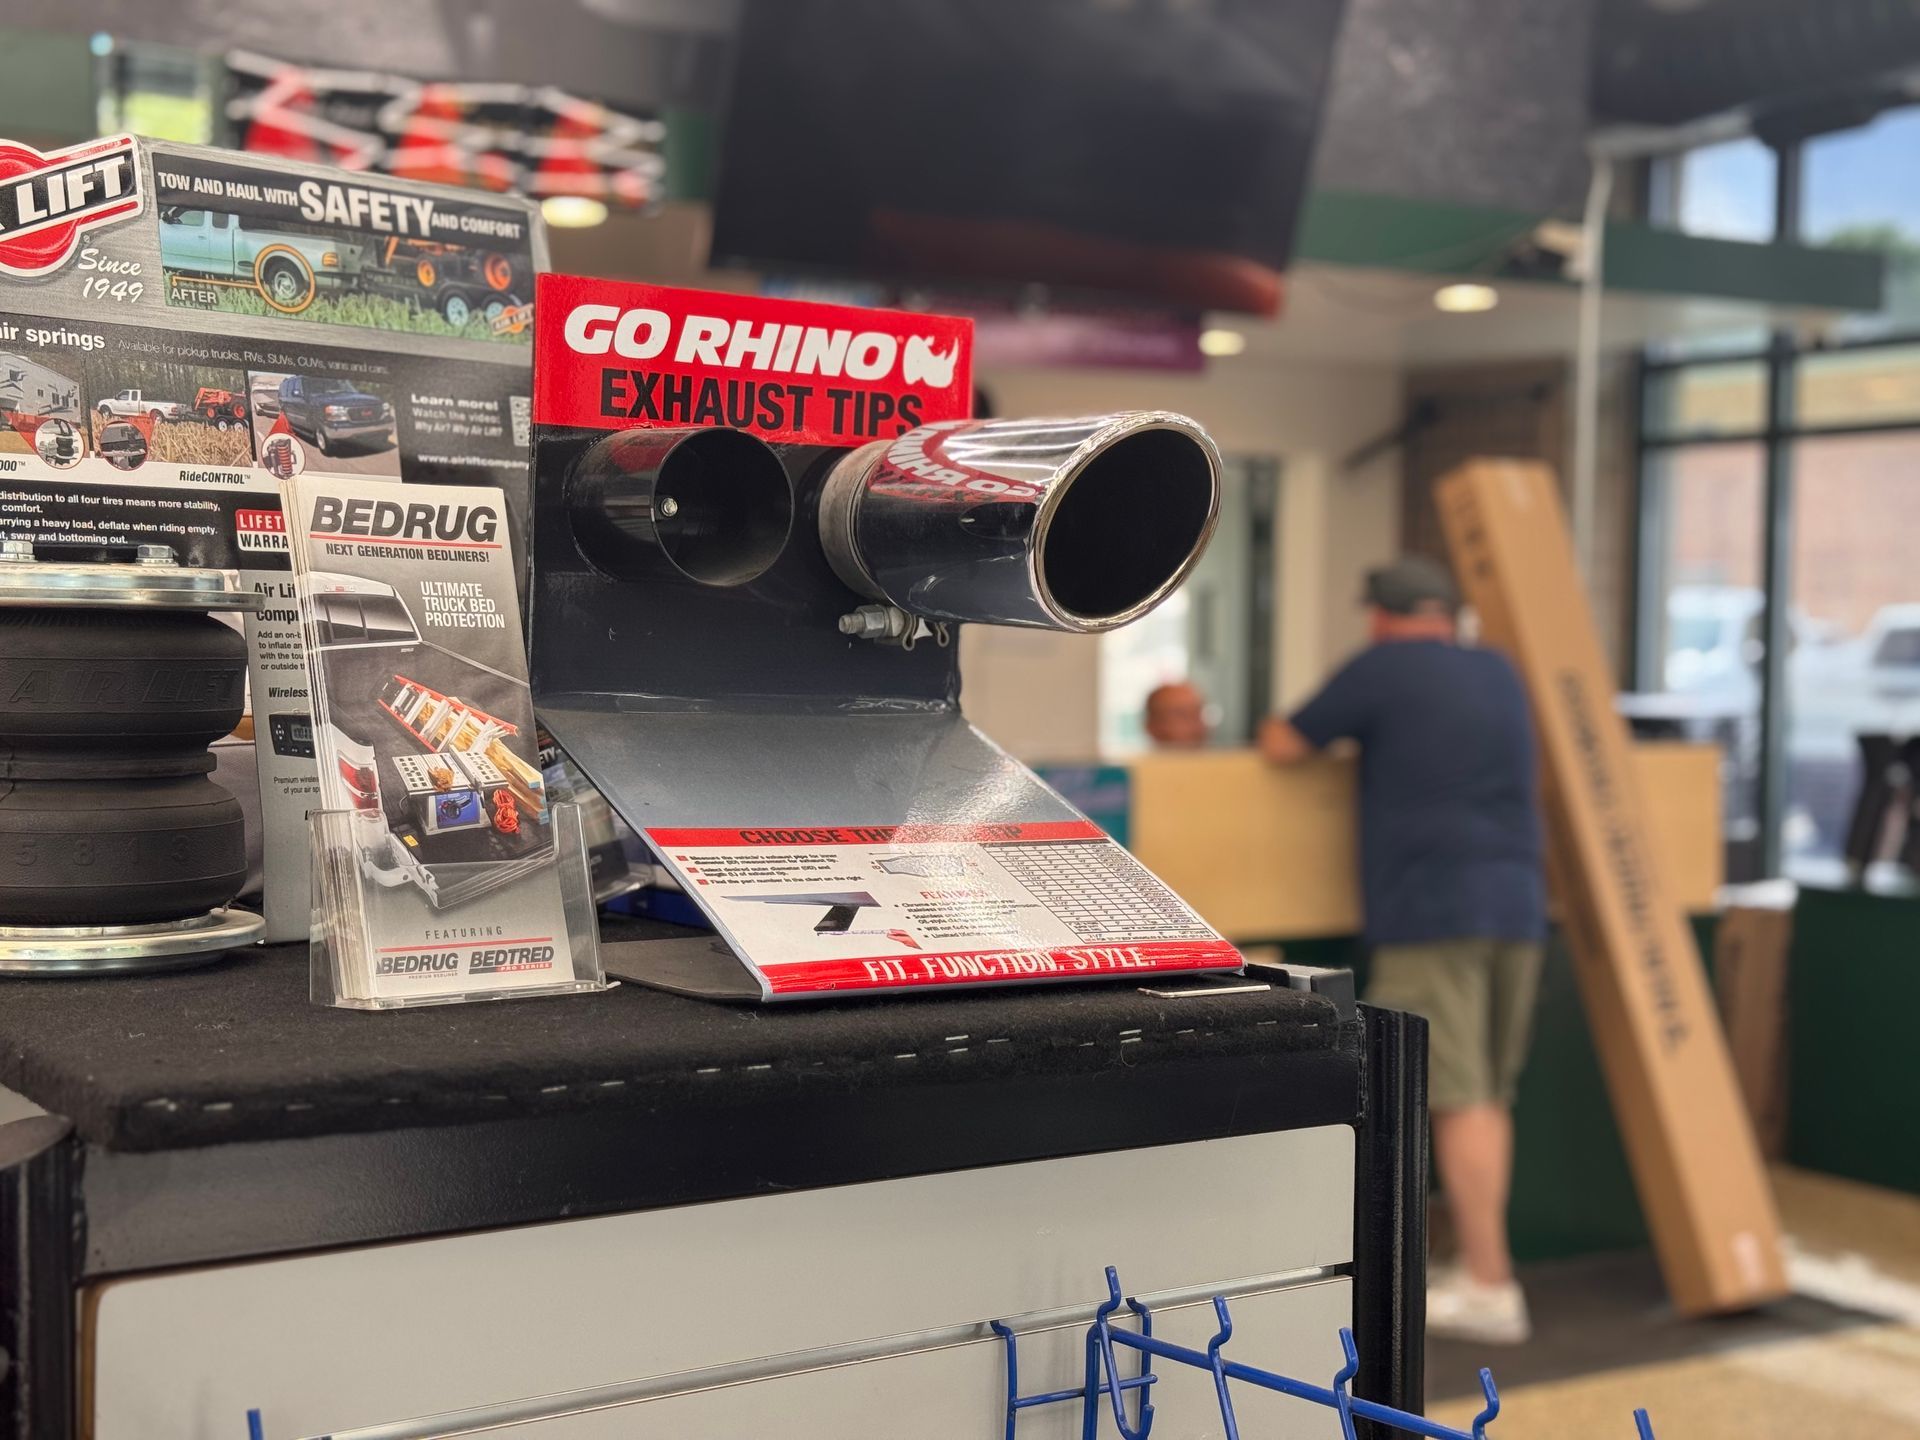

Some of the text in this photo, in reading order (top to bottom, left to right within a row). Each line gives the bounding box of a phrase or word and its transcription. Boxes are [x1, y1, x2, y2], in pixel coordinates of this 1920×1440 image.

[15, 155, 125, 225] LIFT
[158, 171, 520, 239] TOW AND HAUL WITH SAFETY AND COMFORT
[78, 248, 142, 275] Since
[81, 276, 145, 304] 1949
[171, 287, 217, 304] AFTER
[26, 328, 105, 351] springs
[564, 303, 898, 381] GO RHINO
[119, 339, 160, 354] Available
[162, 344, 175, 355] for
[177, 346, 209, 360] pickup
[211, 348, 242, 362] trucks,
[244, 350, 266, 364] RVs,
[267, 353, 297, 367] SUVs,
[411, 393, 499, 411] Learn more!
[599, 367, 923, 437] EXHAUST TIPS
[412, 407, 447, 419] Watch
[448, 410, 467, 421] the
[2, 504, 44, 513] comfort.
[55, 494, 66, 503] to
[67, 495, 79, 503] all
[80, 495, 101, 505] four
[102, 496, 124, 506] tires
[125, 499, 157, 507] means
[158, 500, 182, 509] more
[183, 501, 221, 512] stability,
[33, 519, 41, 527] a
[42, 518, 70, 530] heavy
[72, 520, 96, 531] load,
[98, 521, 130, 530] deflate
[132, 523, 157, 531] when
[159, 523, 185, 535] riding
[187, 526, 218, 535] empty.
[310, 496, 498, 543] BEDRUG
[10, 533, 36, 542] sway
[38, 532, 57, 541] and
[58, 532, 108, 545] bottoming
[109, 536, 129, 545] out.
[325, 543, 490, 563] NEXT GENERATION BEDLINERS!
[254, 582, 275, 598] Air
[420, 581, 484, 598] ULTIMATE
[422, 597, 496, 613] TRUCK BED
[424, 612, 506, 629] PROTECTION
[257, 630, 273, 639] Add
[258, 641, 267, 649] to
[268, 641, 292, 649] inflate
[259, 652, 276, 660] with
[277, 652, 290, 660] the
[270, 662, 299, 671] outside
[268, 687, 309, 698] Wireless
[739, 829, 849, 845] CHOOSE
[849, 827, 894, 842] THE
[425, 926, 503, 939] FEATURING
[381, 946, 555, 974] BEDRUG BEDTRED
[862, 946, 1157, 982] FIT. FUNCTION. STYLE.
